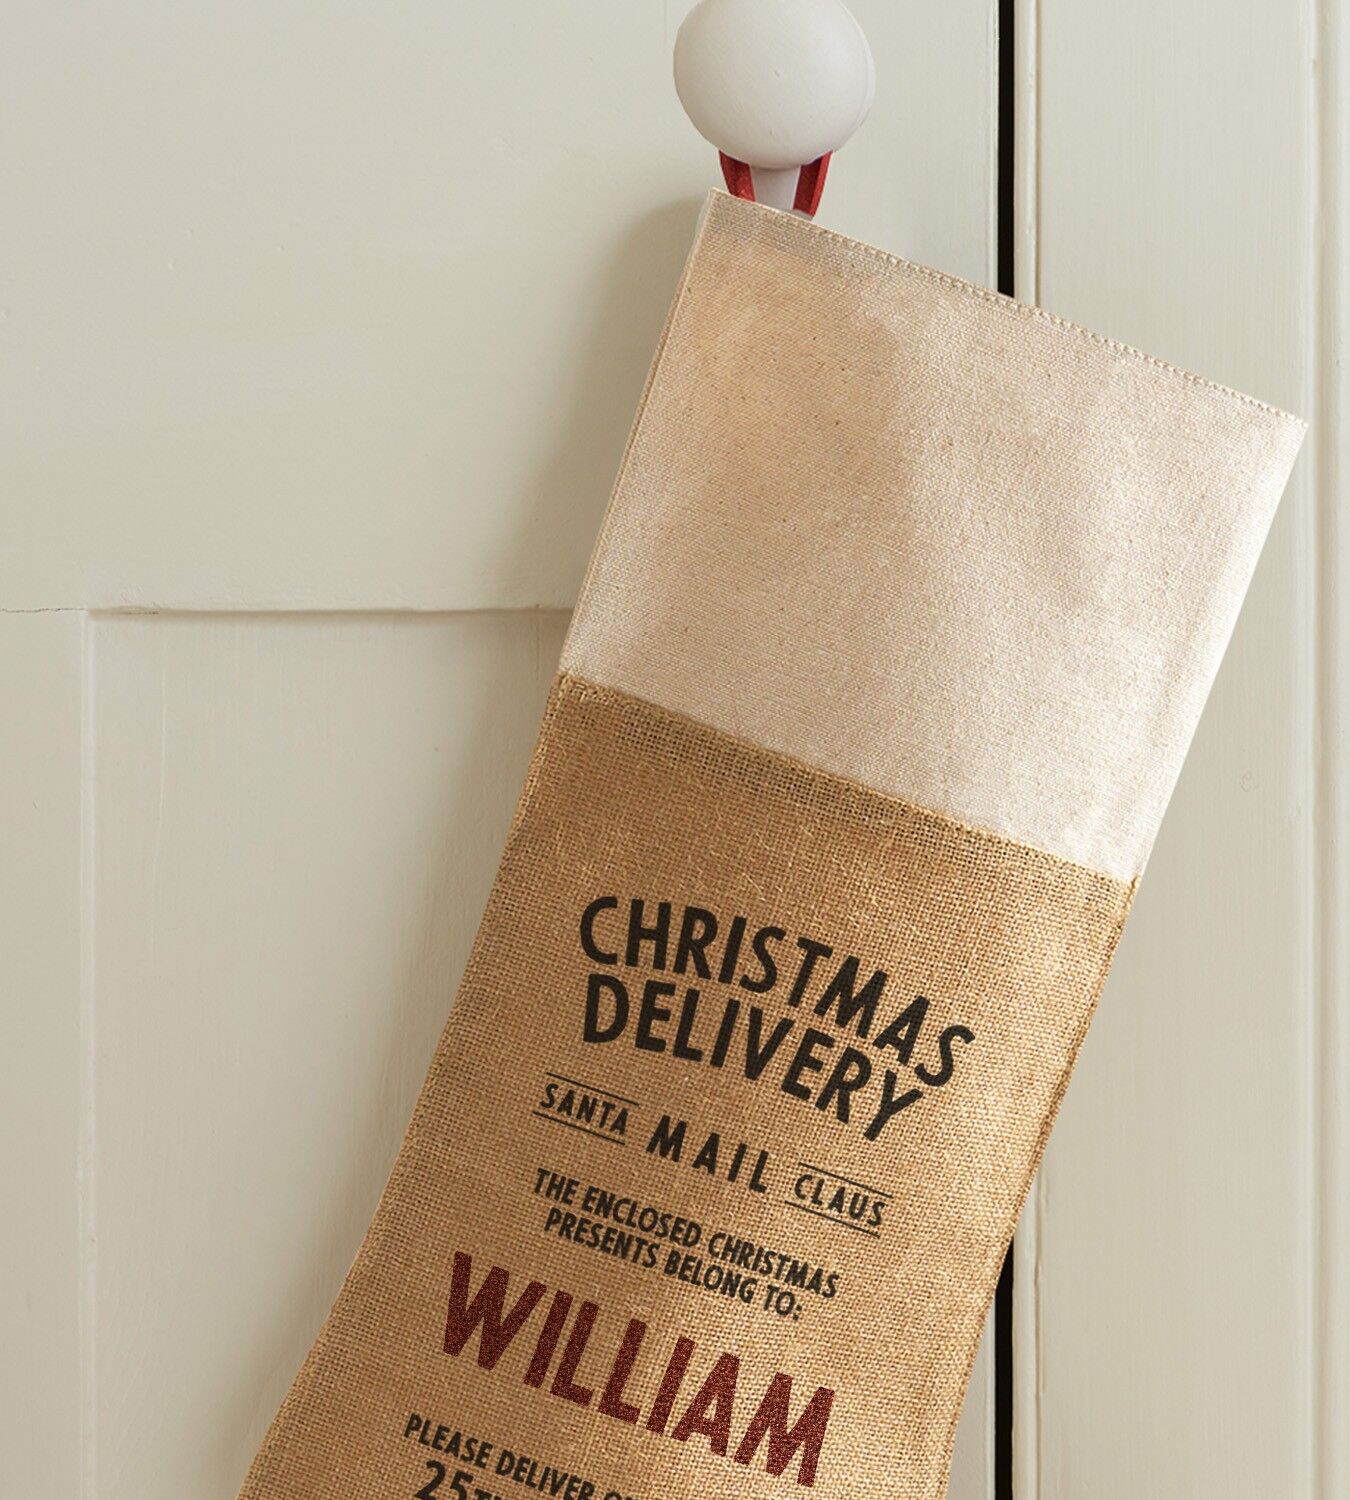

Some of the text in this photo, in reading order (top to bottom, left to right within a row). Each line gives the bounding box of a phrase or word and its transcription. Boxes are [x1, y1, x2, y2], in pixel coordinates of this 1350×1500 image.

[579, 895, 974, 1088] CHRISTMAS
[583, 975, 922, 1142] DELIVERY
[540, 1083, 885, 1226] SANTA MAIL CLAUS
[534, 1168, 839, 1299] THE ENCLOSED CHRISTMAS
[545, 1209, 802, 1321] PRESENTS BELONG TO:
[404, 1413, 492, 1462] PLEASE
[443, 1251, 835, 1488] WILLIAM
